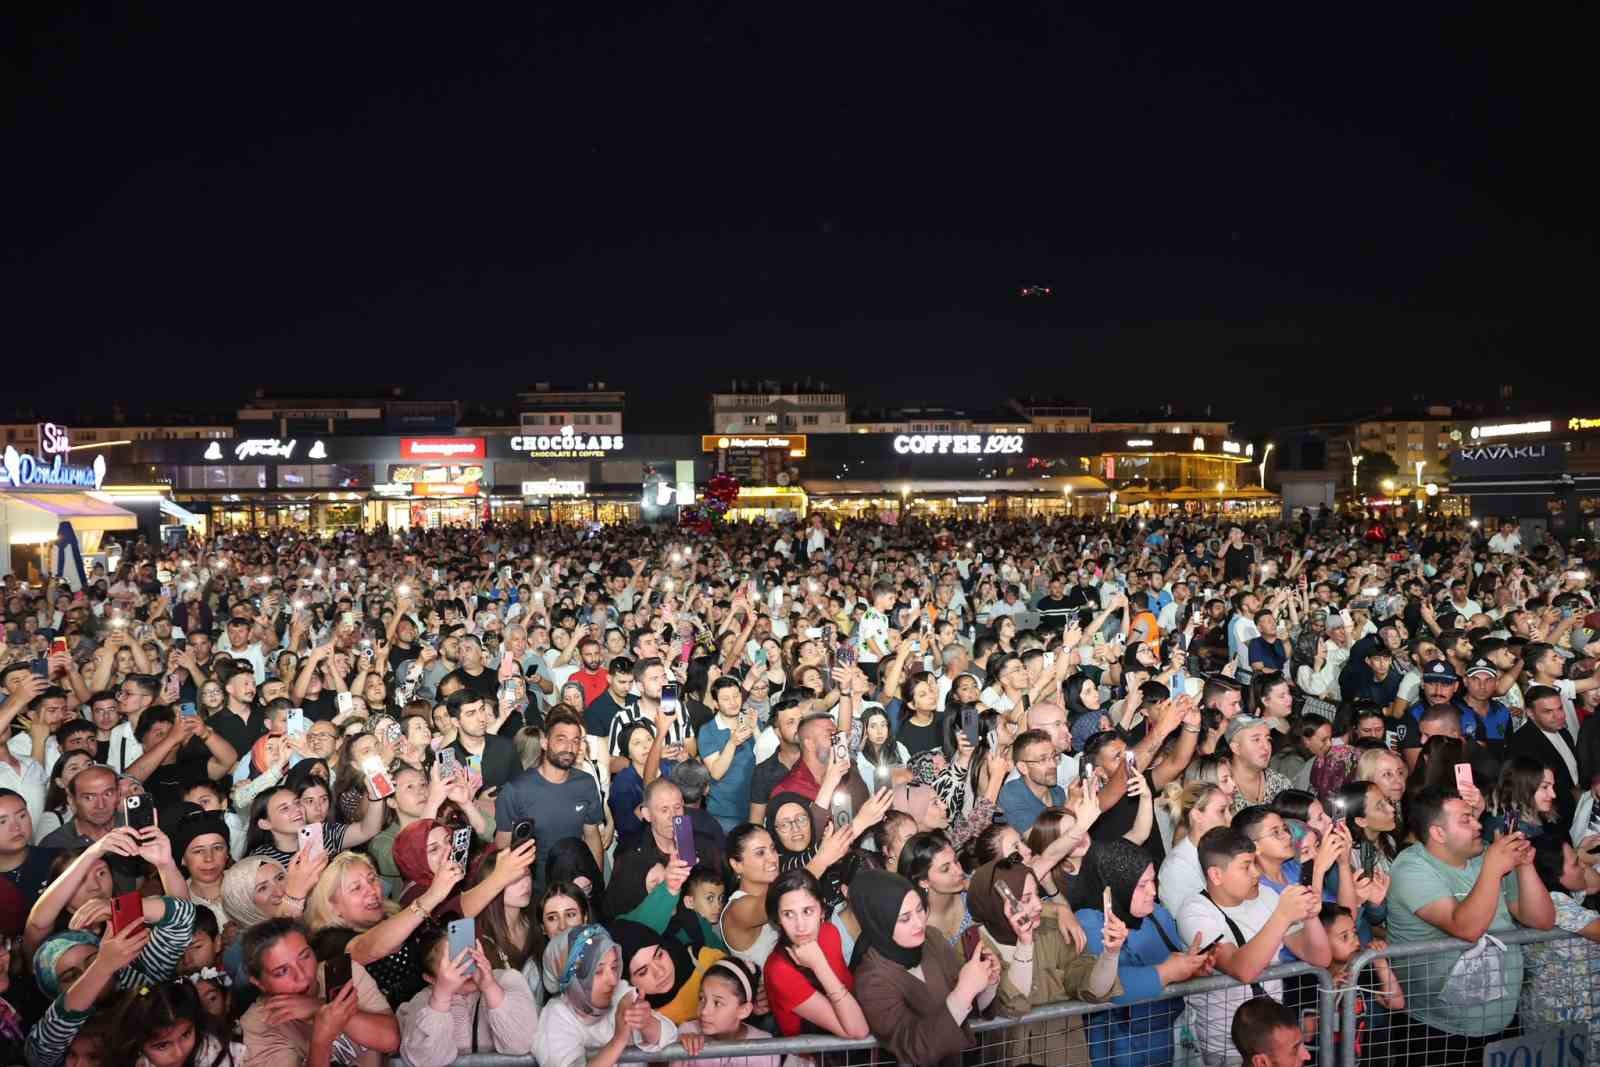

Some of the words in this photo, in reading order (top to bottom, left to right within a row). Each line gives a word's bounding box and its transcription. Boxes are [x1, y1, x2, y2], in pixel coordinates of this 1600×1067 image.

[511, 435, 624, 450] CHOCOLABS
[894, 435, 981, 454] COFFEE
[19, 454, 96, 485] Dondurma
